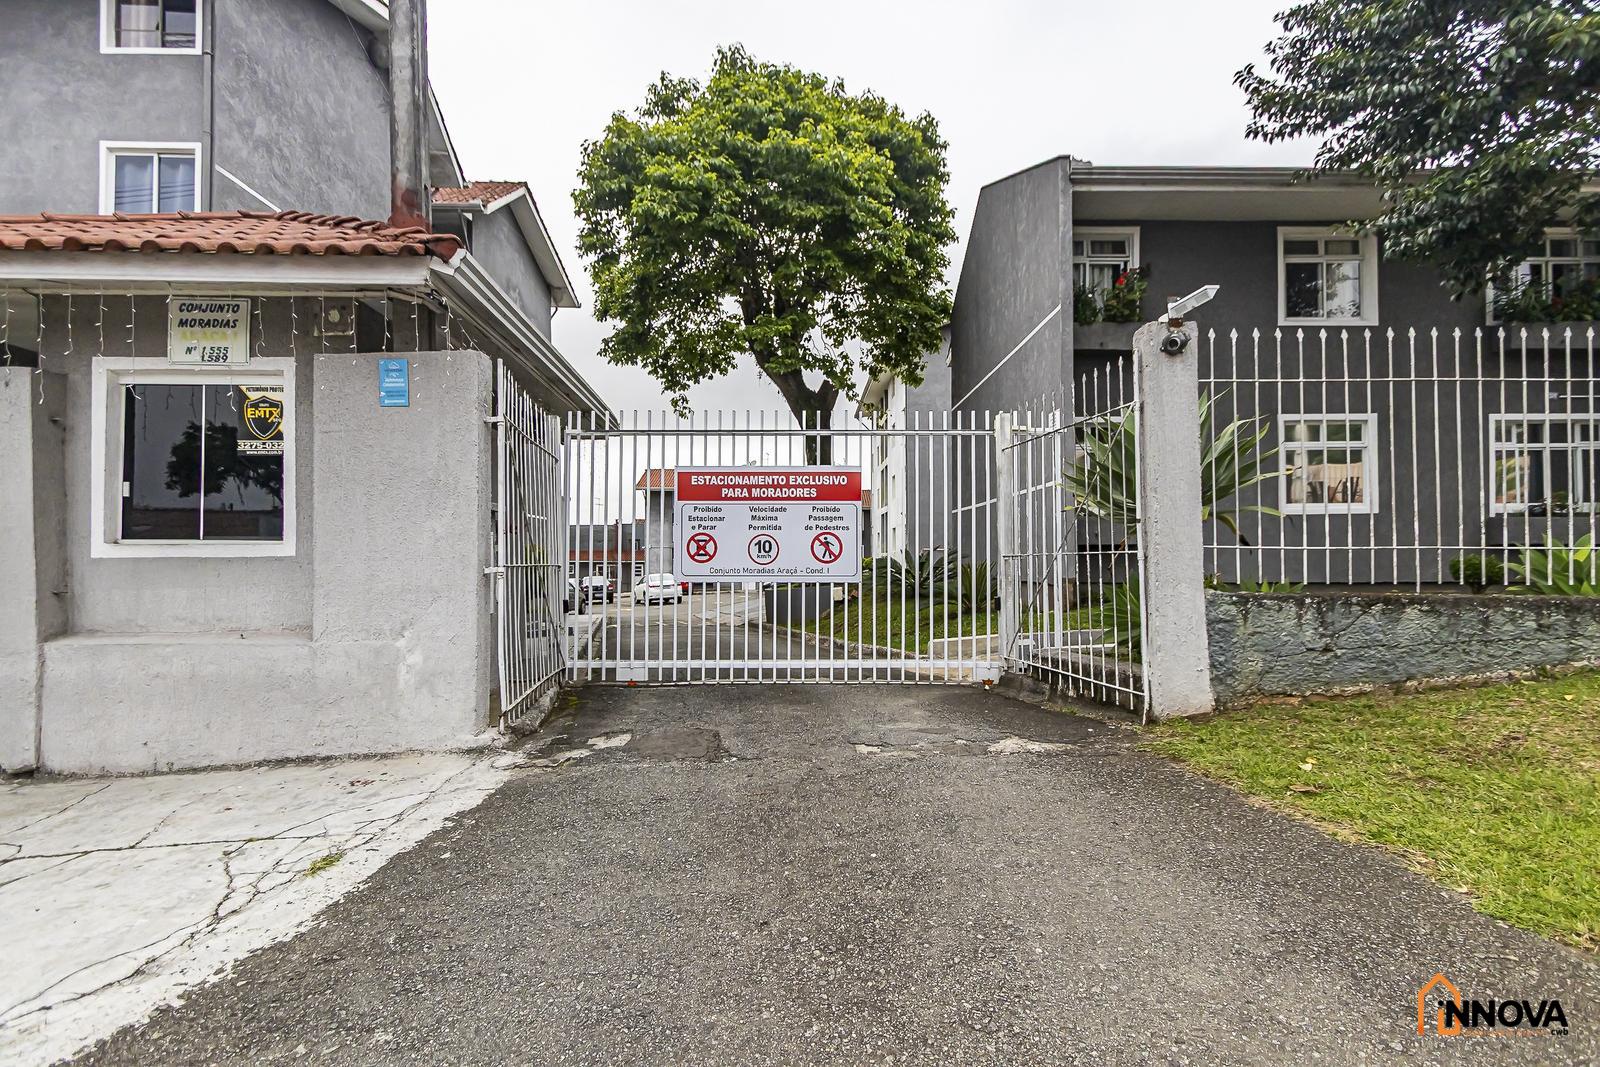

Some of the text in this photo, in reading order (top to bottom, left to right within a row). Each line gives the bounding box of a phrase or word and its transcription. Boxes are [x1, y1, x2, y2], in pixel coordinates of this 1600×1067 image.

[178, 303, 240, 313] CONJUNTO
[177, 318, 239, 328] MORADIAS
[201, 346, 229, 355] 1.555
[247, 408, 280, 423] EMTX
[691, 475, 848, 485] ESTACIONAMENTO EXCLUSIVO
[721, 488, 817, 498] PARA MORADORES
[751, 514, 778, 522] Máxima
[808, 515, 844, 523] Passagem
[754, 540, 772, 554] 10
[709, 566, 741, 575] Conjunto
[777, 566, 798, 575] Araçá
